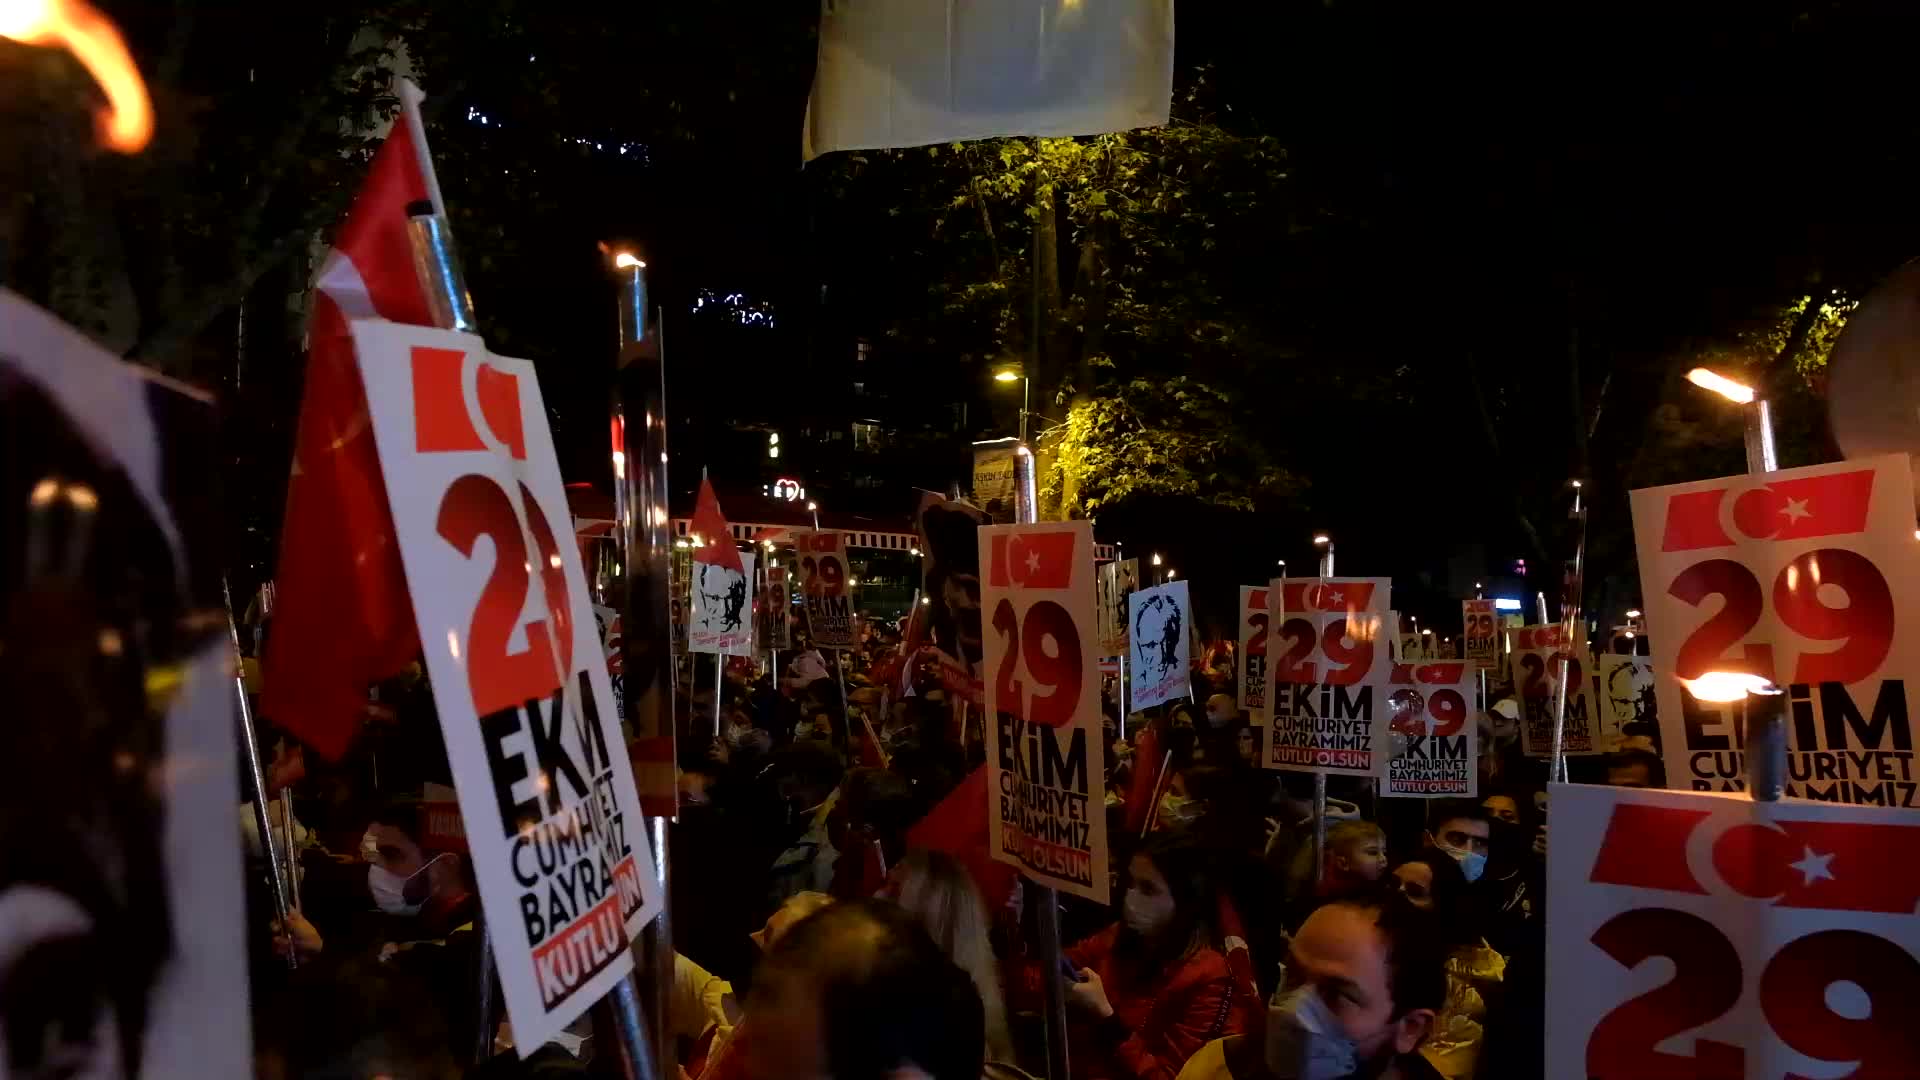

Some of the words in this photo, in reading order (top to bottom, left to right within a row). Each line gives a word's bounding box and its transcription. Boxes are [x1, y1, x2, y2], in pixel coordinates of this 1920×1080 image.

[1666, 547, 1895, 690] 29
[991, 598, 1083, 730] 29
[1278, 618, 1374, 687] 29
[1273, 682, 1373, 721] EKİM
[1389, 689, 1467, 736] 29
[1680, 682, 1913, 752] EİM
[1272, 731, 1372, 752] BAYRAMIMIZ
[1273, 716, 1372, 735] CUMHURİYET
[1272, 747, 1313, 765] KUTLU
[1315, 751, 1371, 770] OLSUN
[1391, 735, 1467, 760] KİM
[1390, 760, 1467, 770] CUMHURİYET
[1390, 769, 1467, 781] BAYRAMIMIZ
[1689, 751, 1914, 782] CUURİYET
[1392, 781, 1427, 792] KUTLU
[1430, 781, 1467, 793] OLSUN
[1032, 846, 1091, 882] OLSUN
[1584, 907, 1920, 1080] 29
